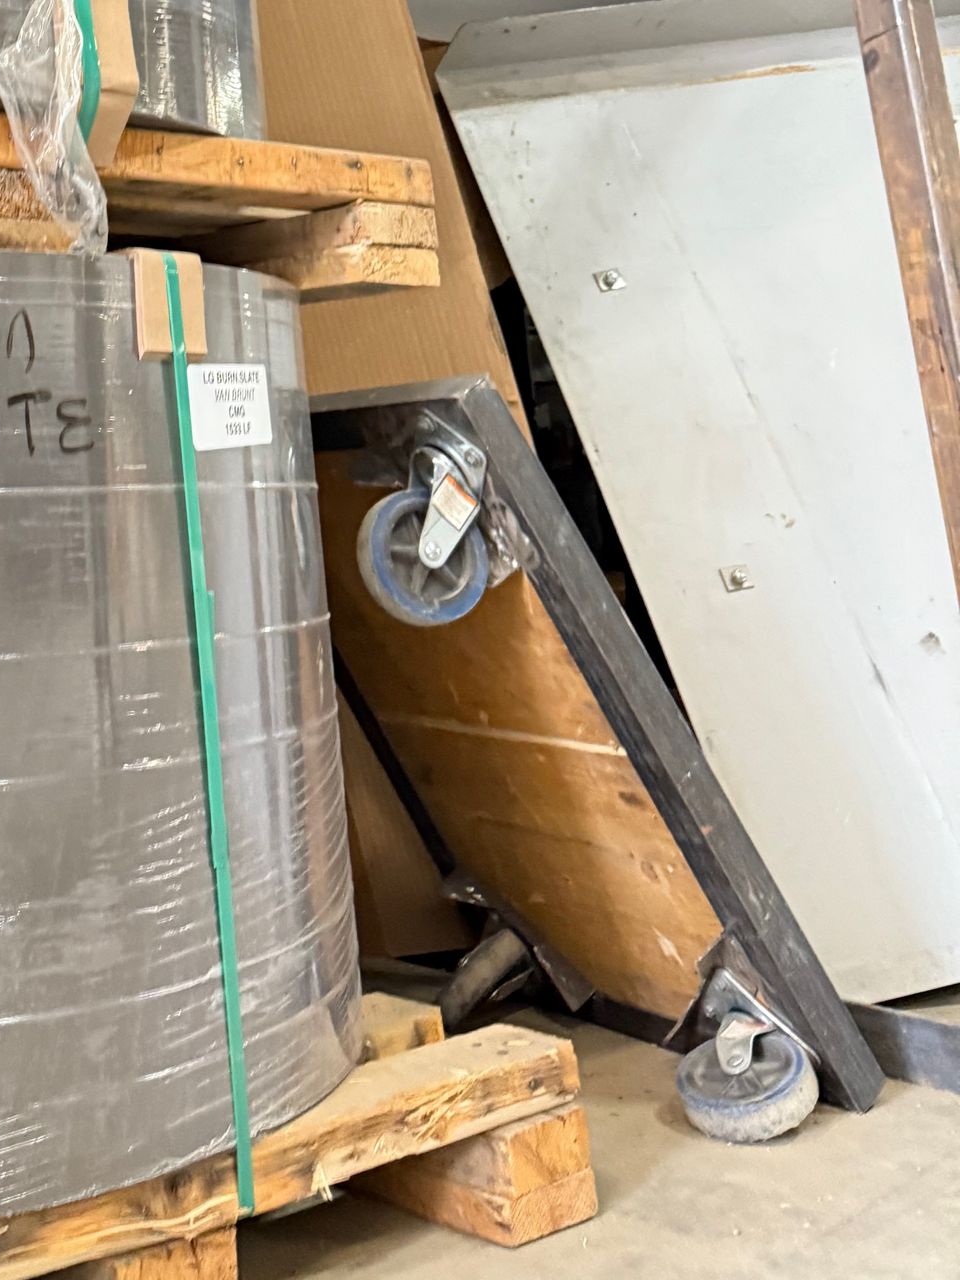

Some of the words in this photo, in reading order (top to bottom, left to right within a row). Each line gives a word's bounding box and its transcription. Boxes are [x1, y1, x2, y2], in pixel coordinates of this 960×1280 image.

[203, 370, 215, 385] LG
[216, 370, 238, 385] BURN
[239, 370, 260, 384] SLATE
[214, 387, 230, 402] VAN
[231, 387, 255, 401] BRUNT
[228, 404, 245, 418] CMG
[225, 422, 242, 436] 1533
[243, 421, 251, 435] LF
